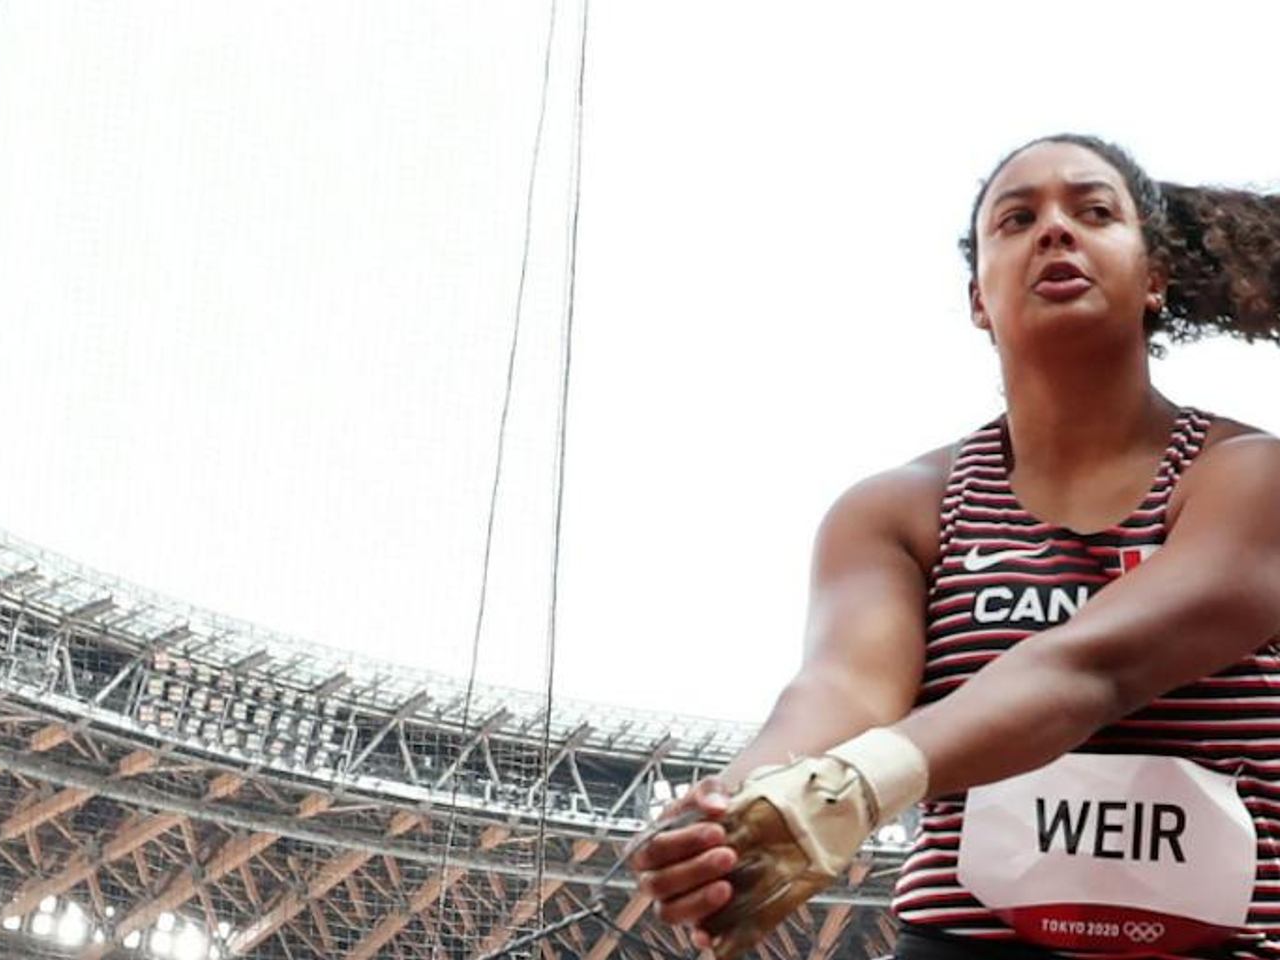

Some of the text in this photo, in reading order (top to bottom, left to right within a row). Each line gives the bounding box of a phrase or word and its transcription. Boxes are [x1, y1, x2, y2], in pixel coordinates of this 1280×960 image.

[1036, 798, 1186, 863] WEIR
[1041, 918, 1120, 937] TOKYO 2020
